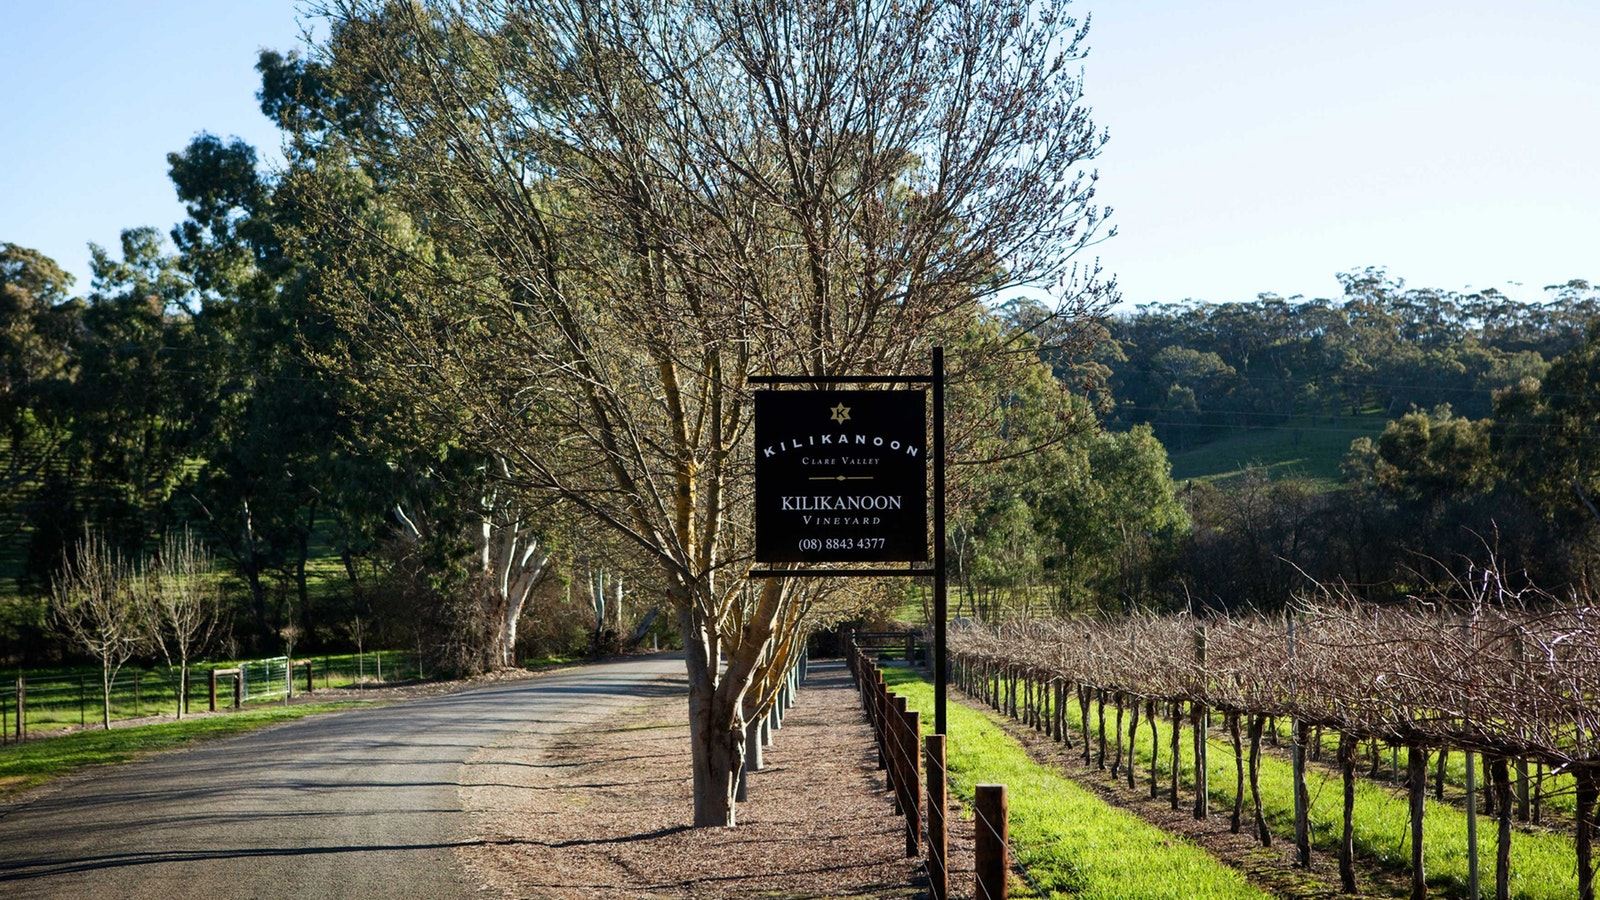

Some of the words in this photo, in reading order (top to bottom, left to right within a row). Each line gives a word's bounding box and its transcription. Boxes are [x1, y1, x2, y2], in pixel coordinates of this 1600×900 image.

[763, 434, 919, 458] KILIKANOON
[781, 495, 902, 511] KILIKANOON
[798, 537, 823, 552] (08)
[825, 537, 854, 550] 8843
[856, 537, 886, 550] 4377
